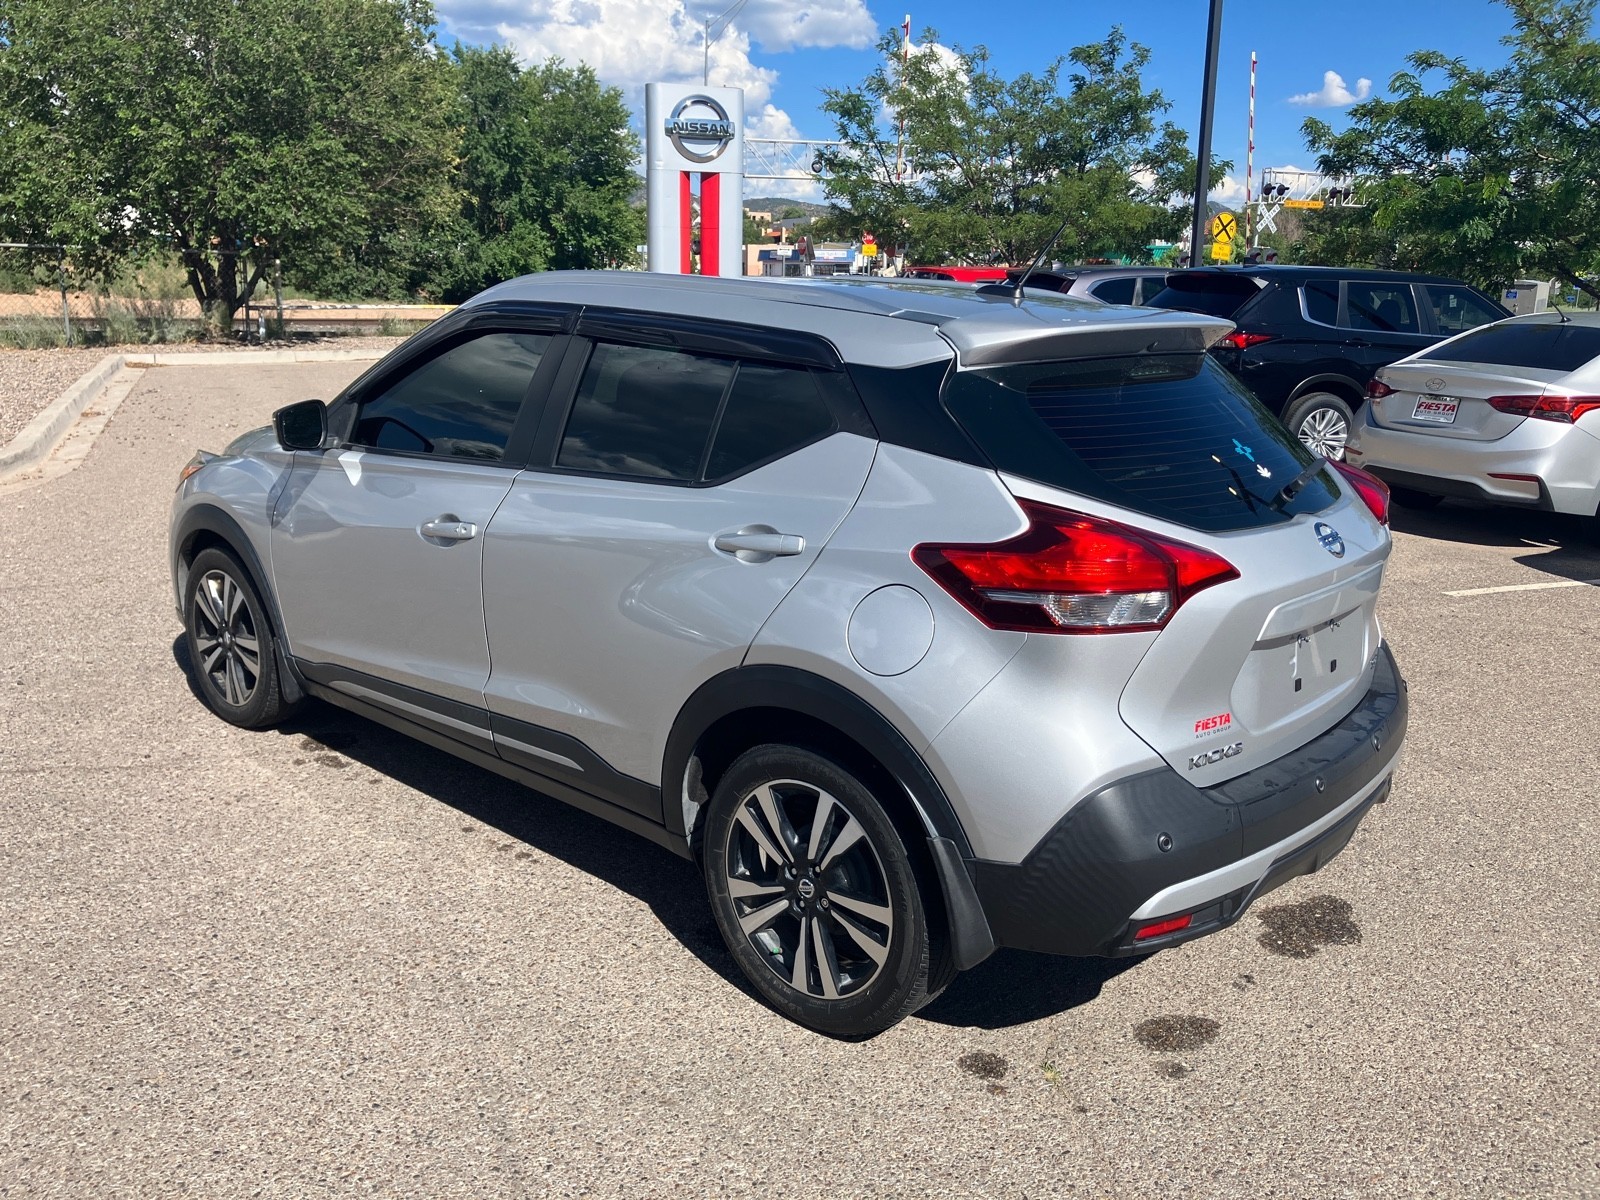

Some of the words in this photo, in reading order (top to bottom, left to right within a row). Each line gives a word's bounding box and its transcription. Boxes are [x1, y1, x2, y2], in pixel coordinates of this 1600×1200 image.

[673, 121, 729, 133] NISSAN
[1195, 731, 1211, 739] AUTO
[1212, 725, 1231, 734] GROUP
[1188, 742, 1243, 771] KICKS
